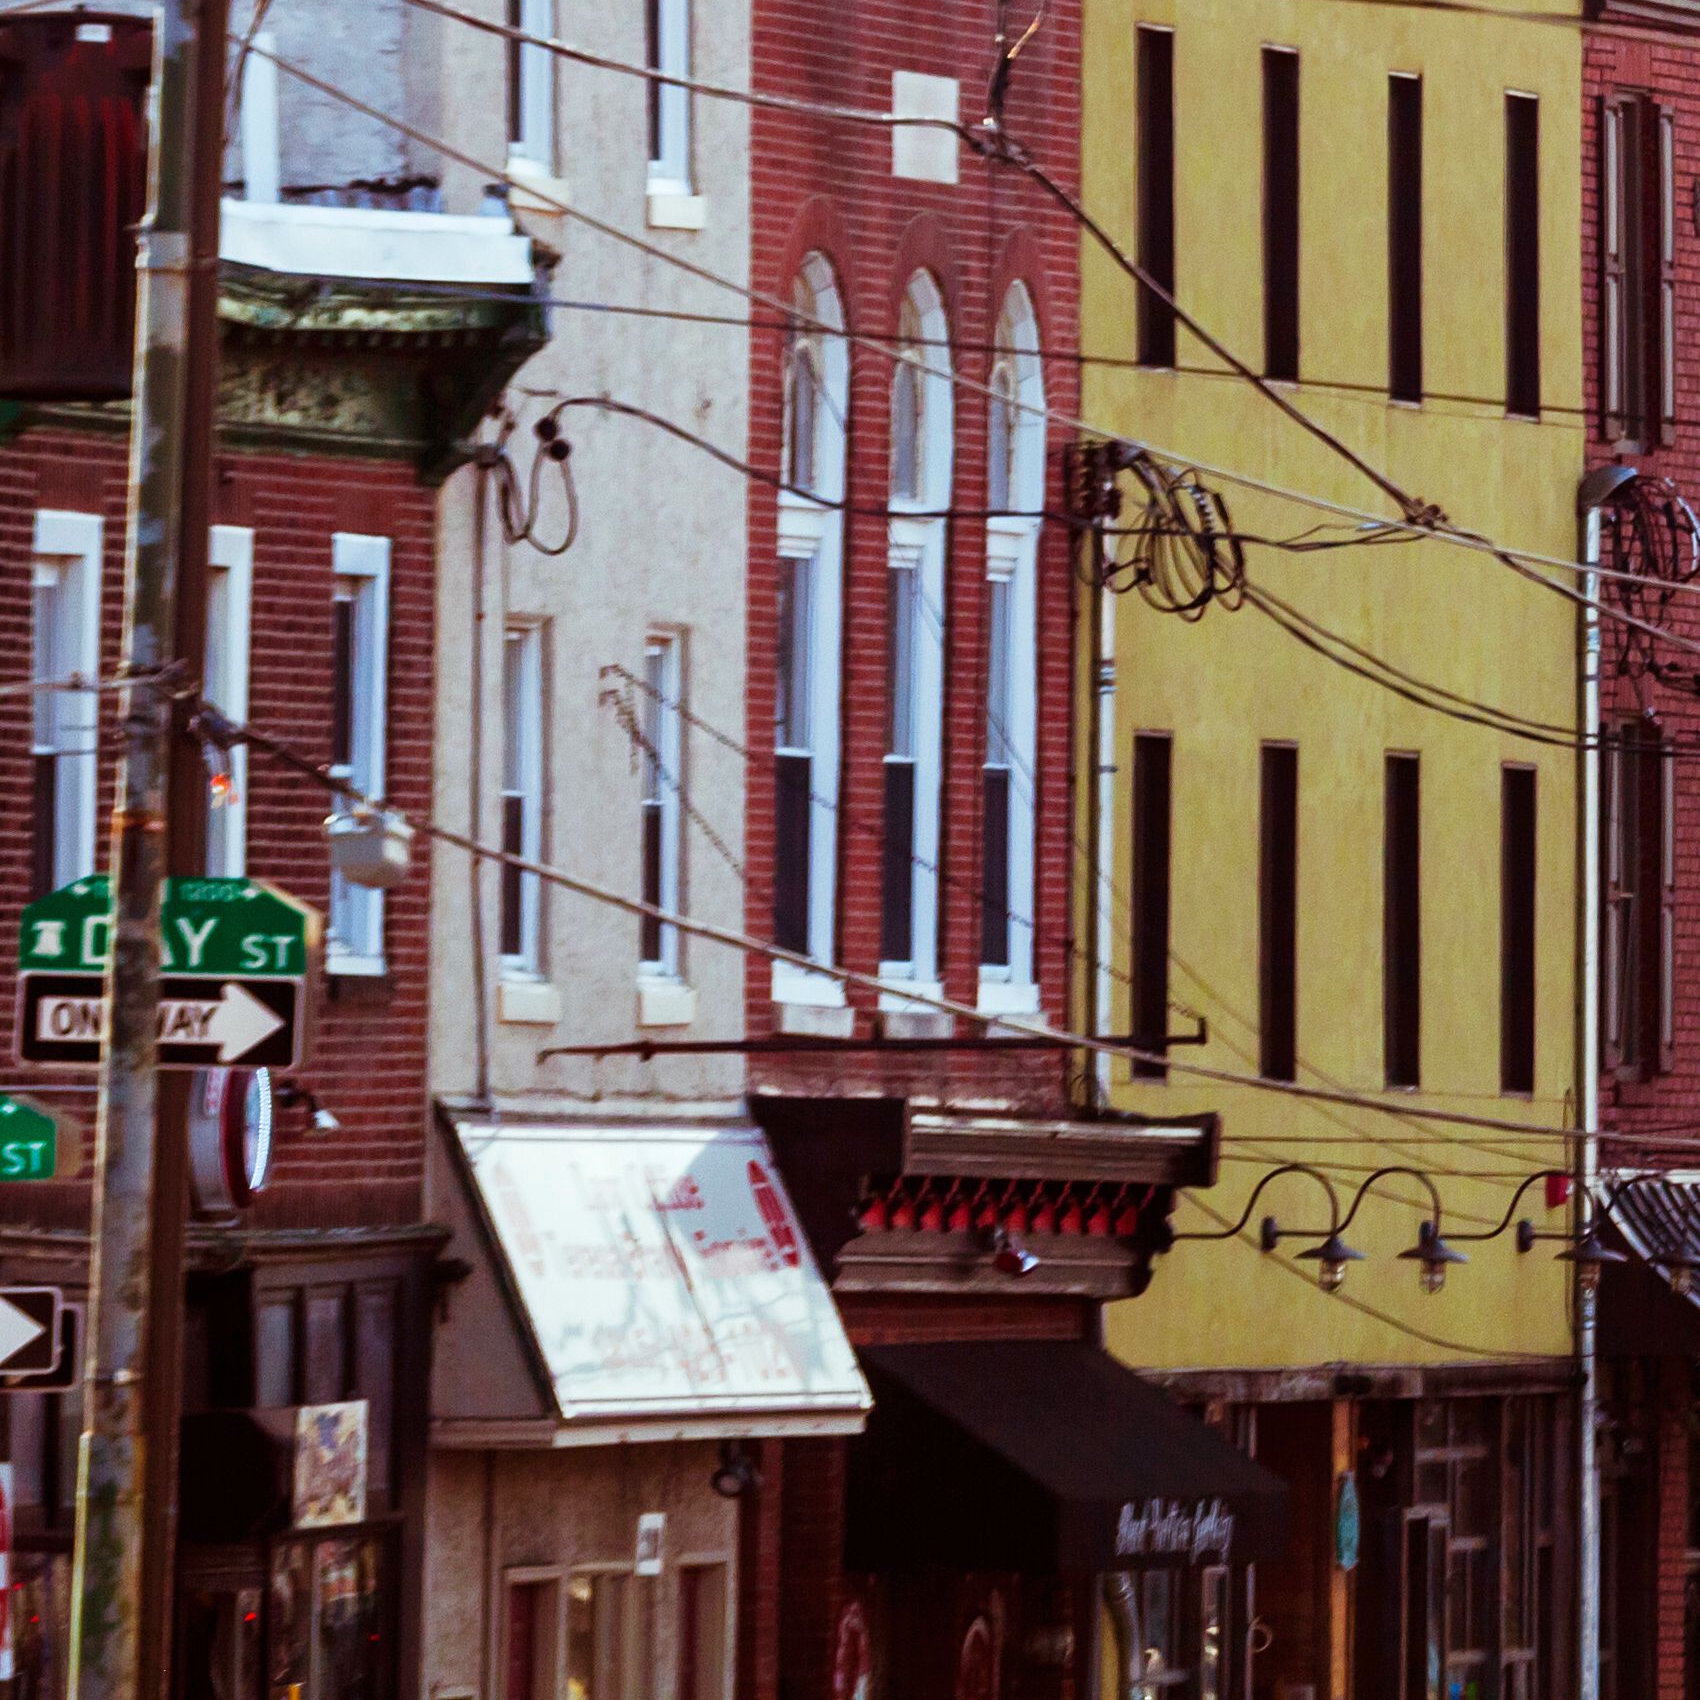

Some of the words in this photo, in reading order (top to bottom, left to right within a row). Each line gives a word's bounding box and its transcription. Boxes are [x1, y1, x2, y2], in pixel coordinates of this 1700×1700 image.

[240, 933, 296, 968] ST
[51, 1002, 112, 1038] ON
[156, 1003, 216, 1038] AY
[3, 1141, 47, 1174] ST
